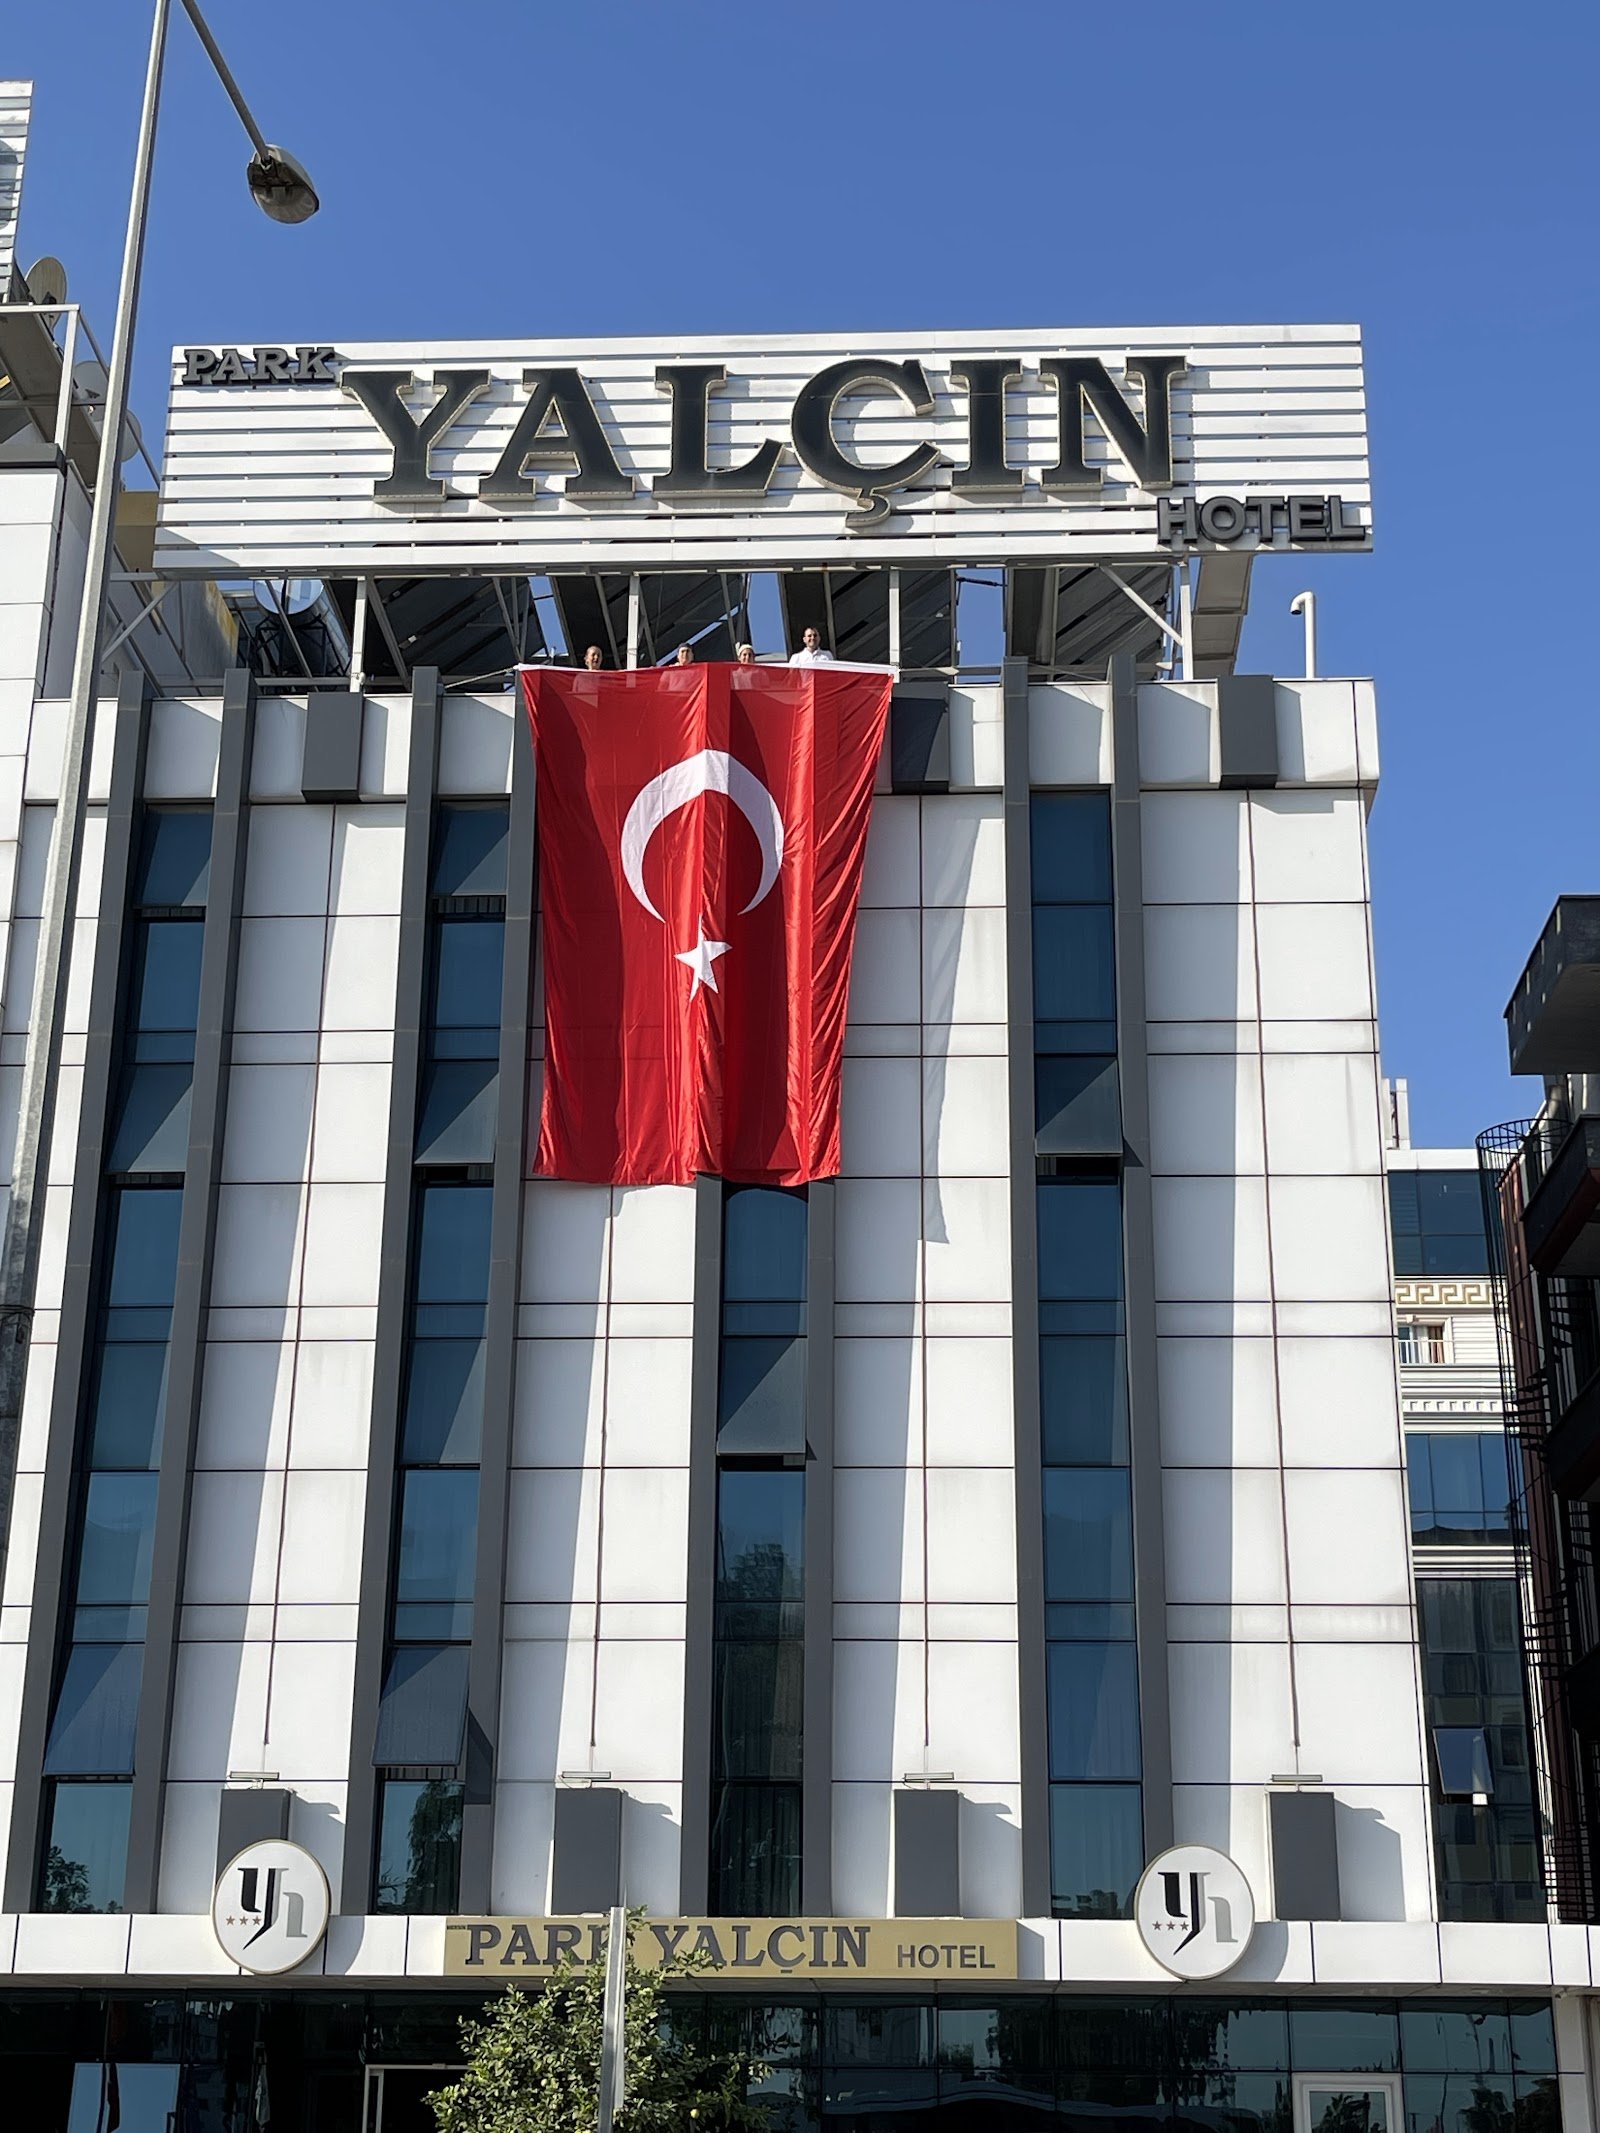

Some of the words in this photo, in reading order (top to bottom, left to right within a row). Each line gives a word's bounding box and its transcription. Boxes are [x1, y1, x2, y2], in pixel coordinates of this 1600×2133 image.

[182, 346, 335, 386] PARK
[340, 355, 1187, 529] YALÇIN
[1156, 495, 1367, 545] HOTEL
[650, 1924, 871, 1974] YALÇIN
[897, 1944, 996, 1969] HOTEL
